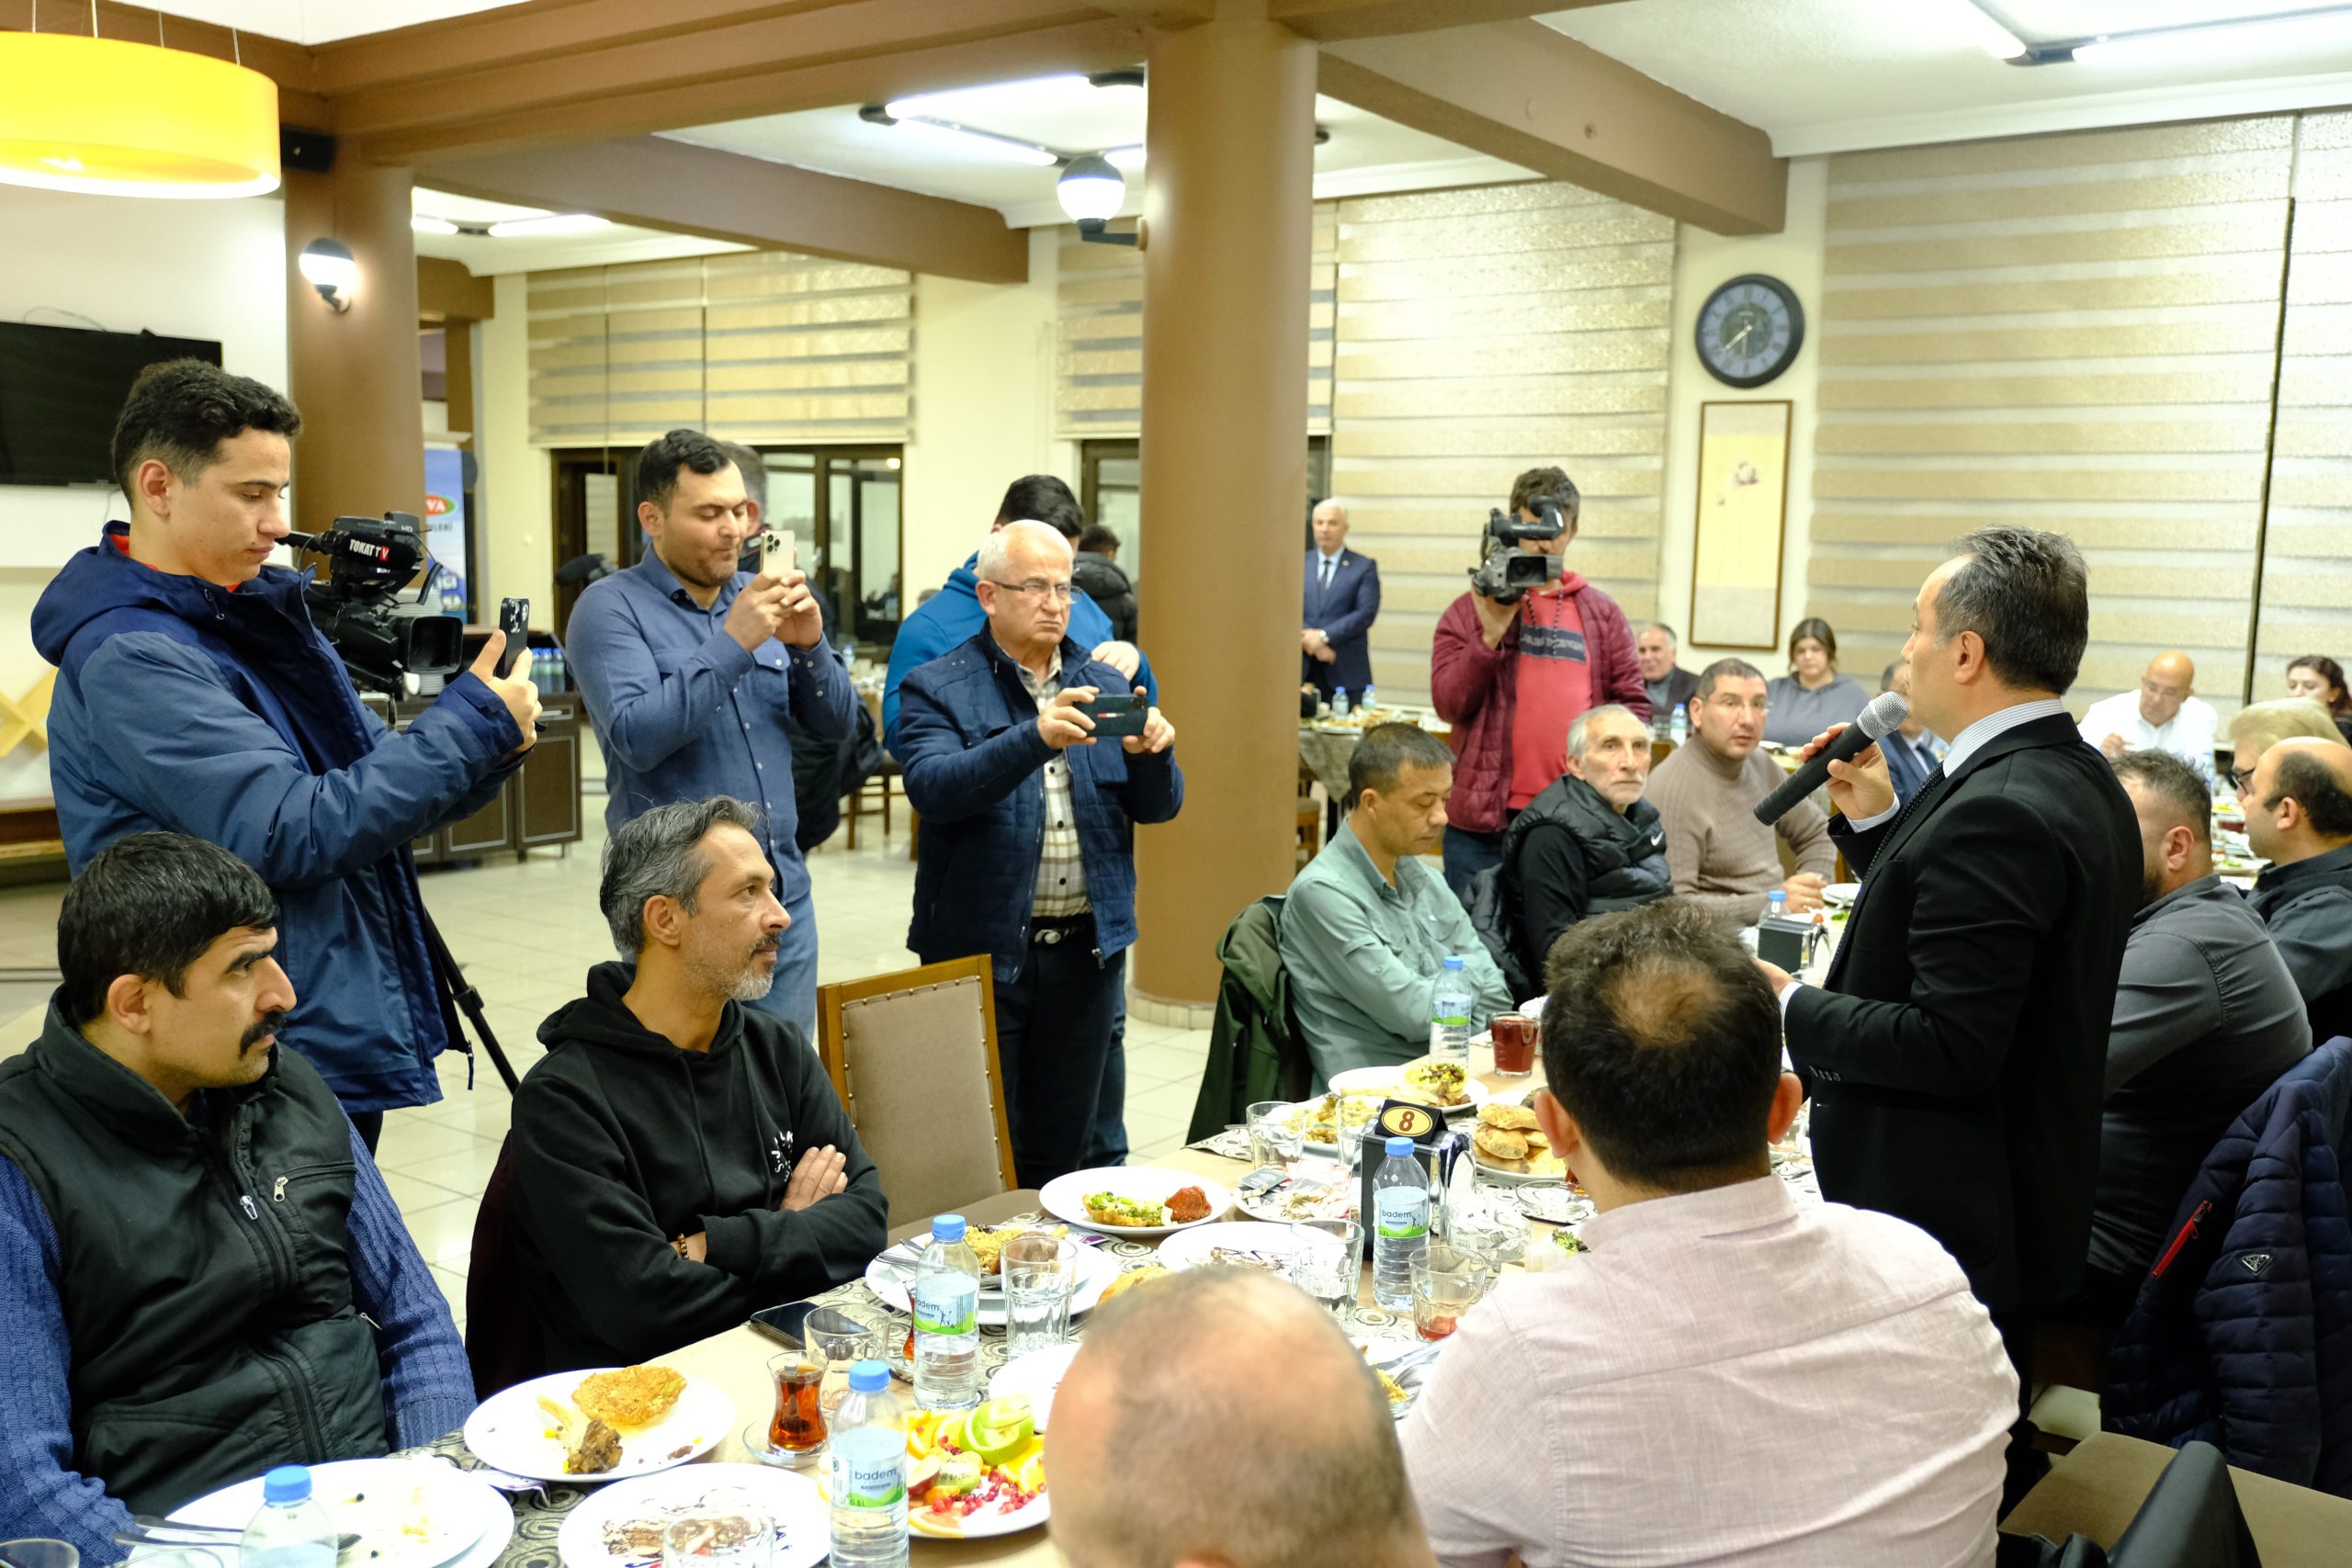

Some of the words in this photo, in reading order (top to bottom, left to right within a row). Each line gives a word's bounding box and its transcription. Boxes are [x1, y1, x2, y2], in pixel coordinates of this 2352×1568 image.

[401, 525, 413, 533] HD
[349, 538, 375, 558] TOKAT
[1398, 1111, 1415, 1133] 8
[1381, 1209, 1411, 1219] badem
[854, 1468, 898, 1481] badem
